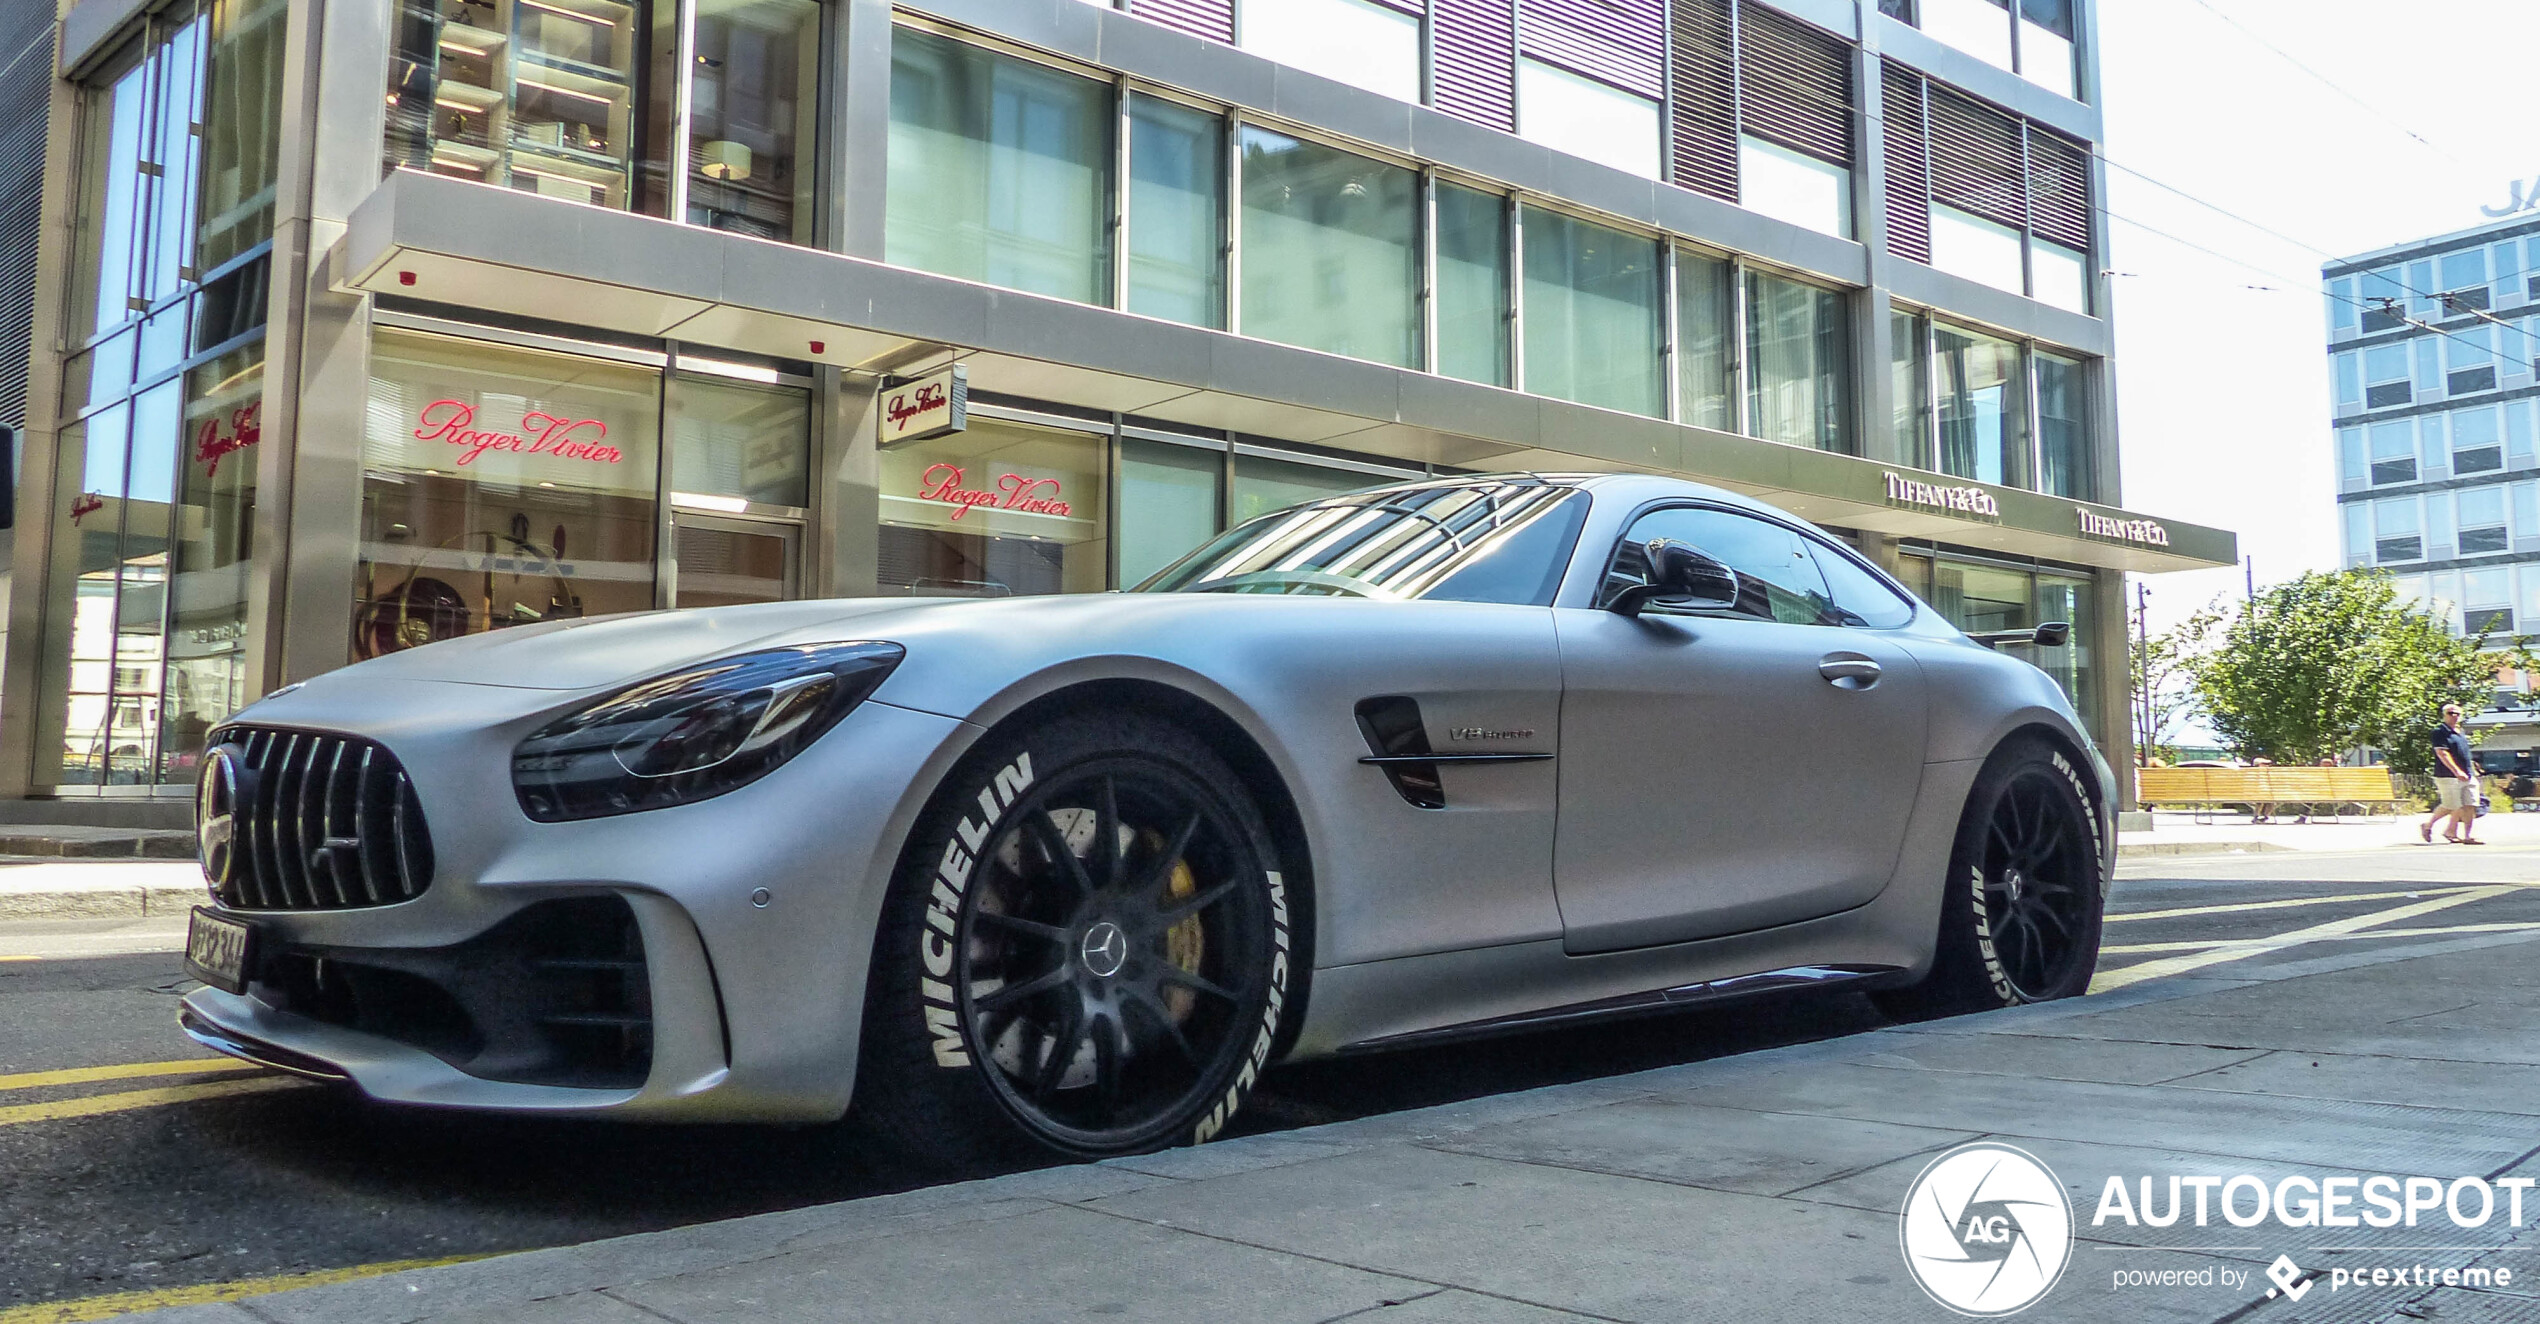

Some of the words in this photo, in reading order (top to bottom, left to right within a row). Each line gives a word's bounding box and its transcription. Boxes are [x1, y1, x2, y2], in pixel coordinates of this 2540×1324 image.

[414, 399, 525, 466] Roger
[522, 411, 623, 464] Vivier
[887, 394, 918, 431] Roger
[915, 382, 947, 414] Vivier
[919, 463, 1000, 521] Roger
[998, 473, 1072, 517] Vivier
[1450, 728, 1482, 740] V8
[922, 752, 1034, 1067] MICHELIN
[1194, 870, 1290, 1145] MICHELIN
